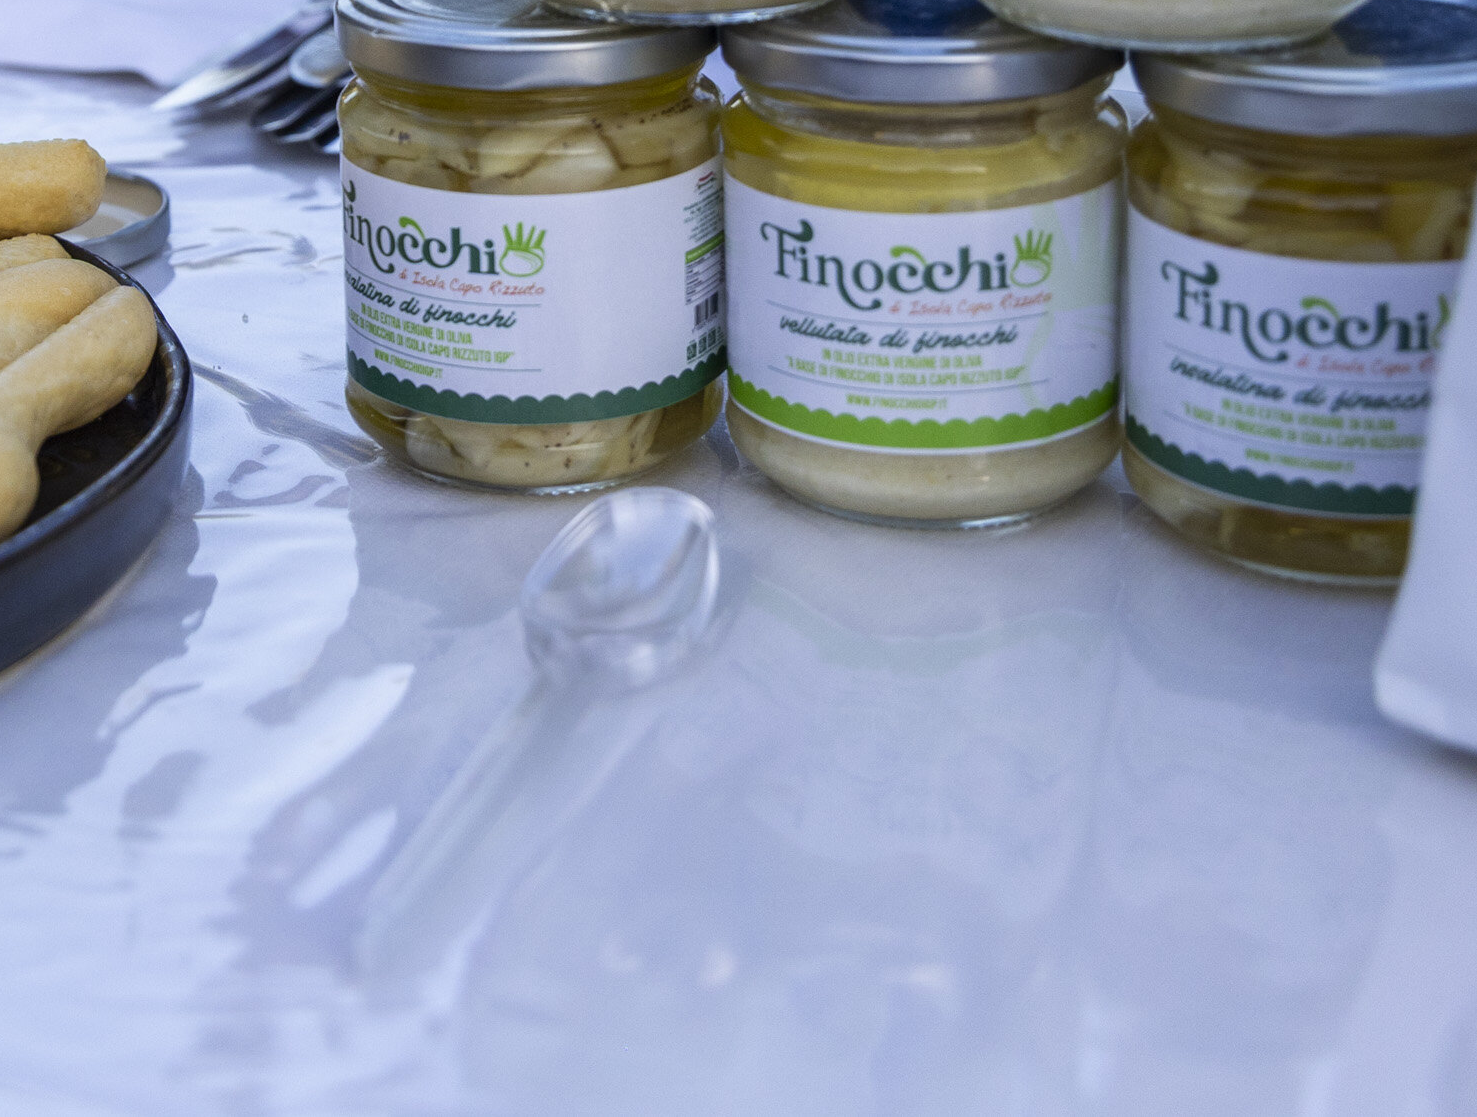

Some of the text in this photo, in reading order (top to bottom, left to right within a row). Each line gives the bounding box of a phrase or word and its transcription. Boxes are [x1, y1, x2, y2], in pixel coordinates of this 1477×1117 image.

[412, 272, 445, 290] Isola
[449, 277, 483, 296] Capo
[489, 280, 546, 296] Rizzuto
[399, 296, 420, 316] di
[422, 303, 517, 329] finocchi
[780, 315, 1018, 353] vellutata di finocchi
